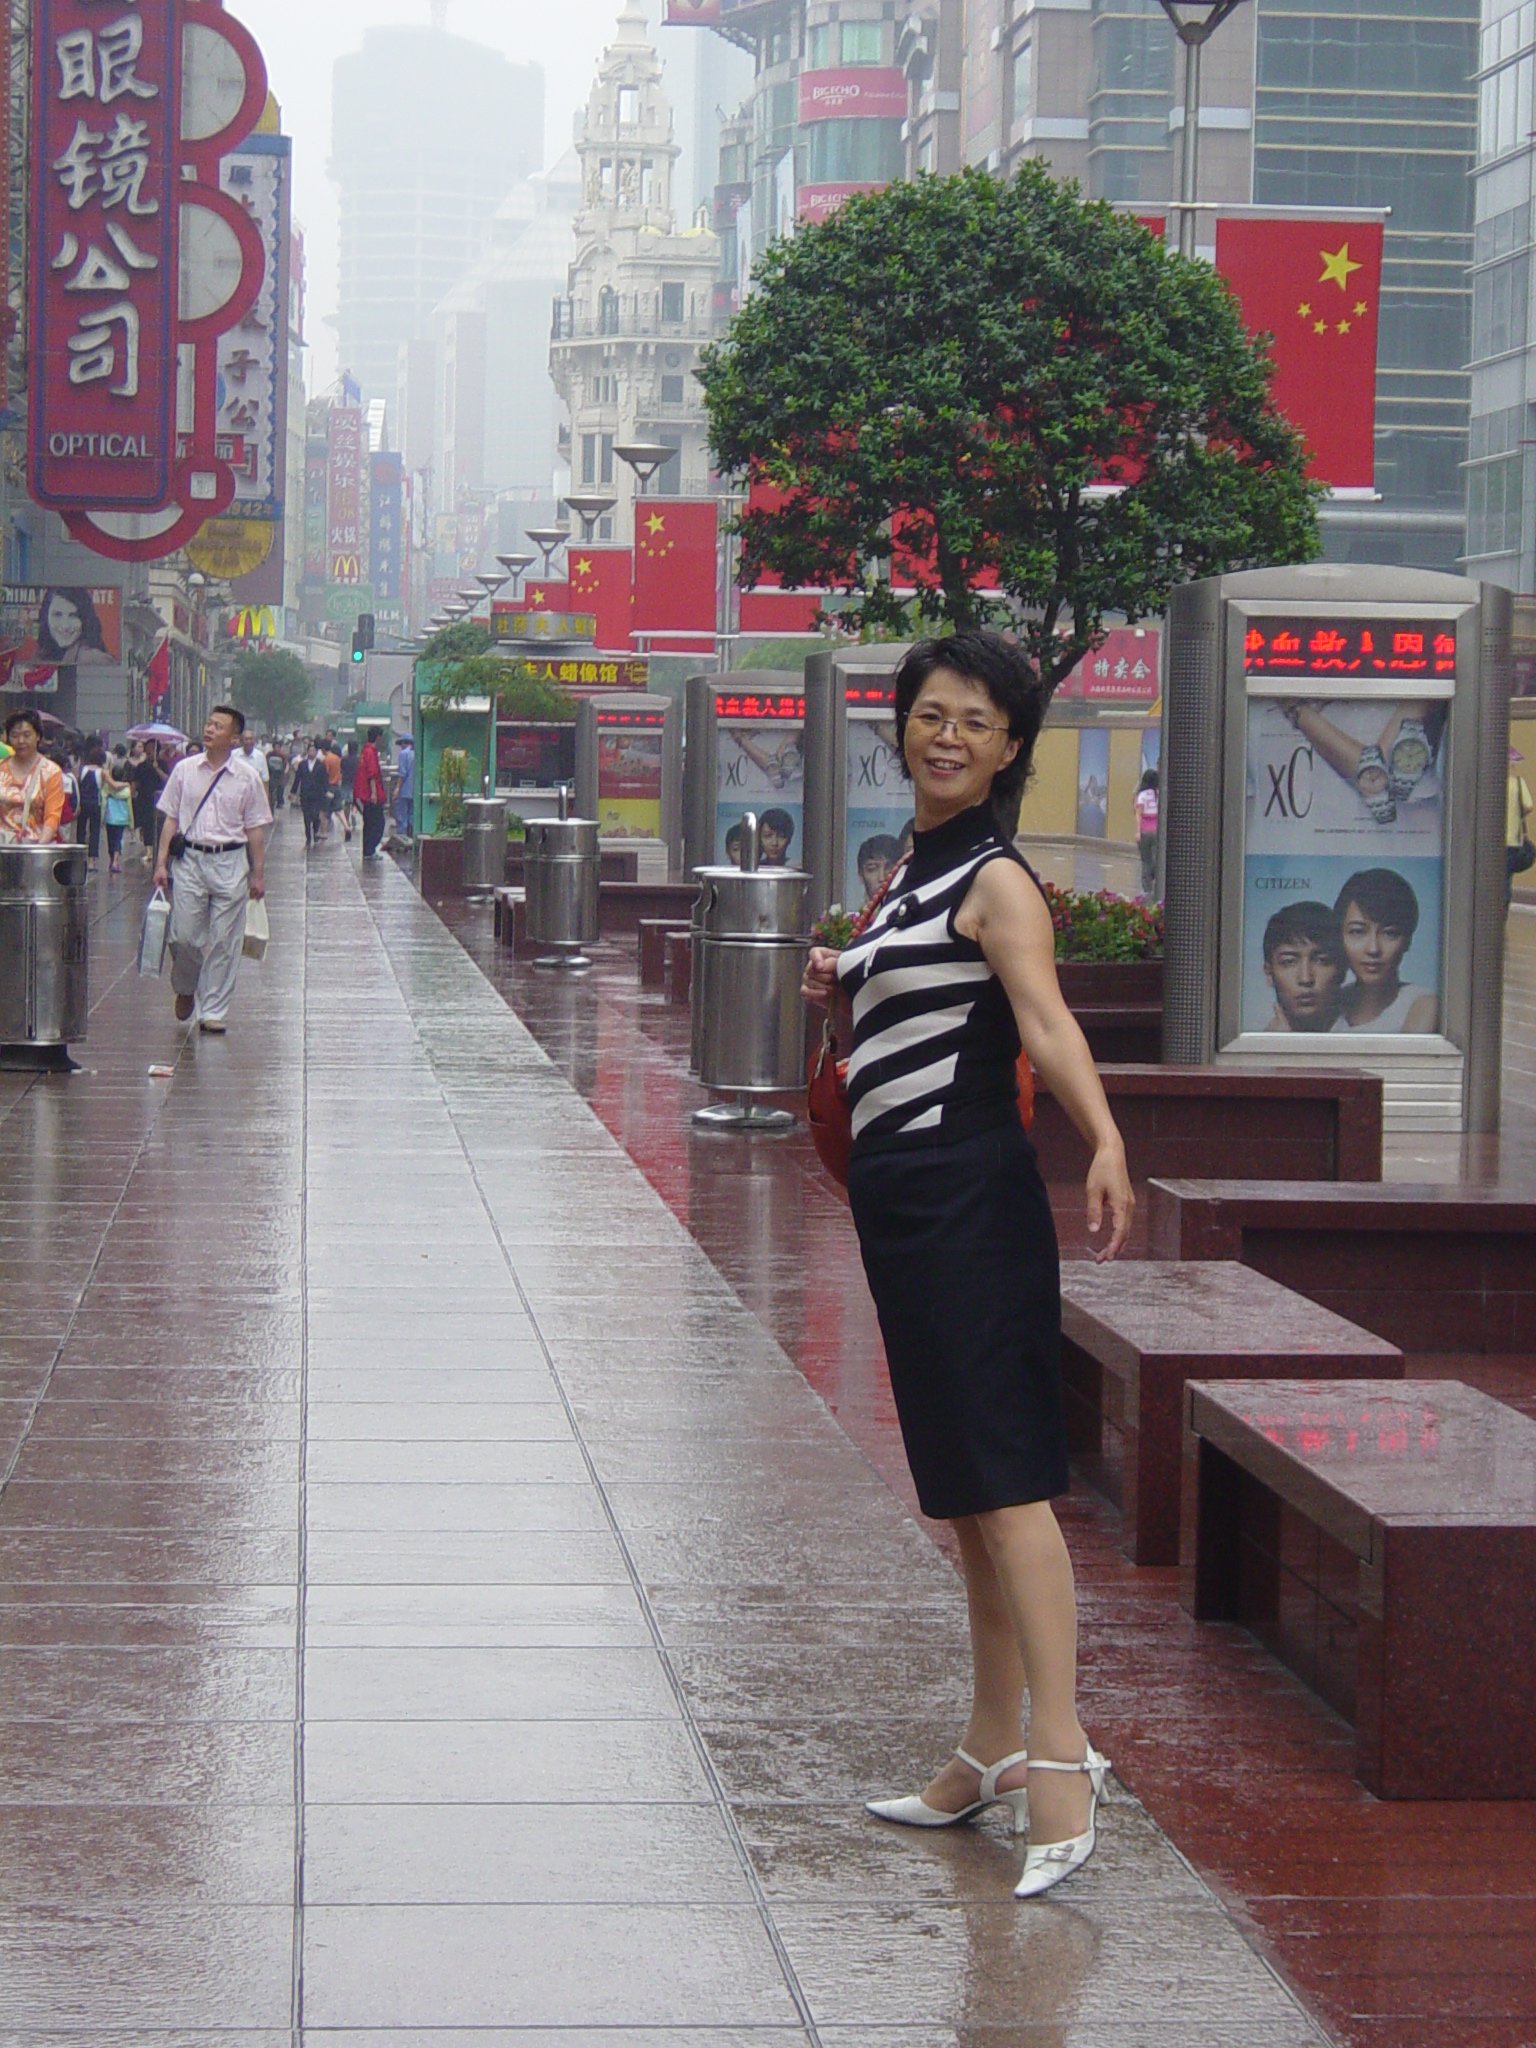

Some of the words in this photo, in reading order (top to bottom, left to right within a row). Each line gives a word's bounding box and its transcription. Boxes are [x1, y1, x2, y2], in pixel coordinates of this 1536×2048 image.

[51, 12, 158, 397] 眼镜公司
[49, 432, 154, 458] OPTICAL
[331, 526, 357, 543] 火锅
[1094, 656, 1152, 680] 特卖会
[1254, 876, 1311, 890] CITIZEN
